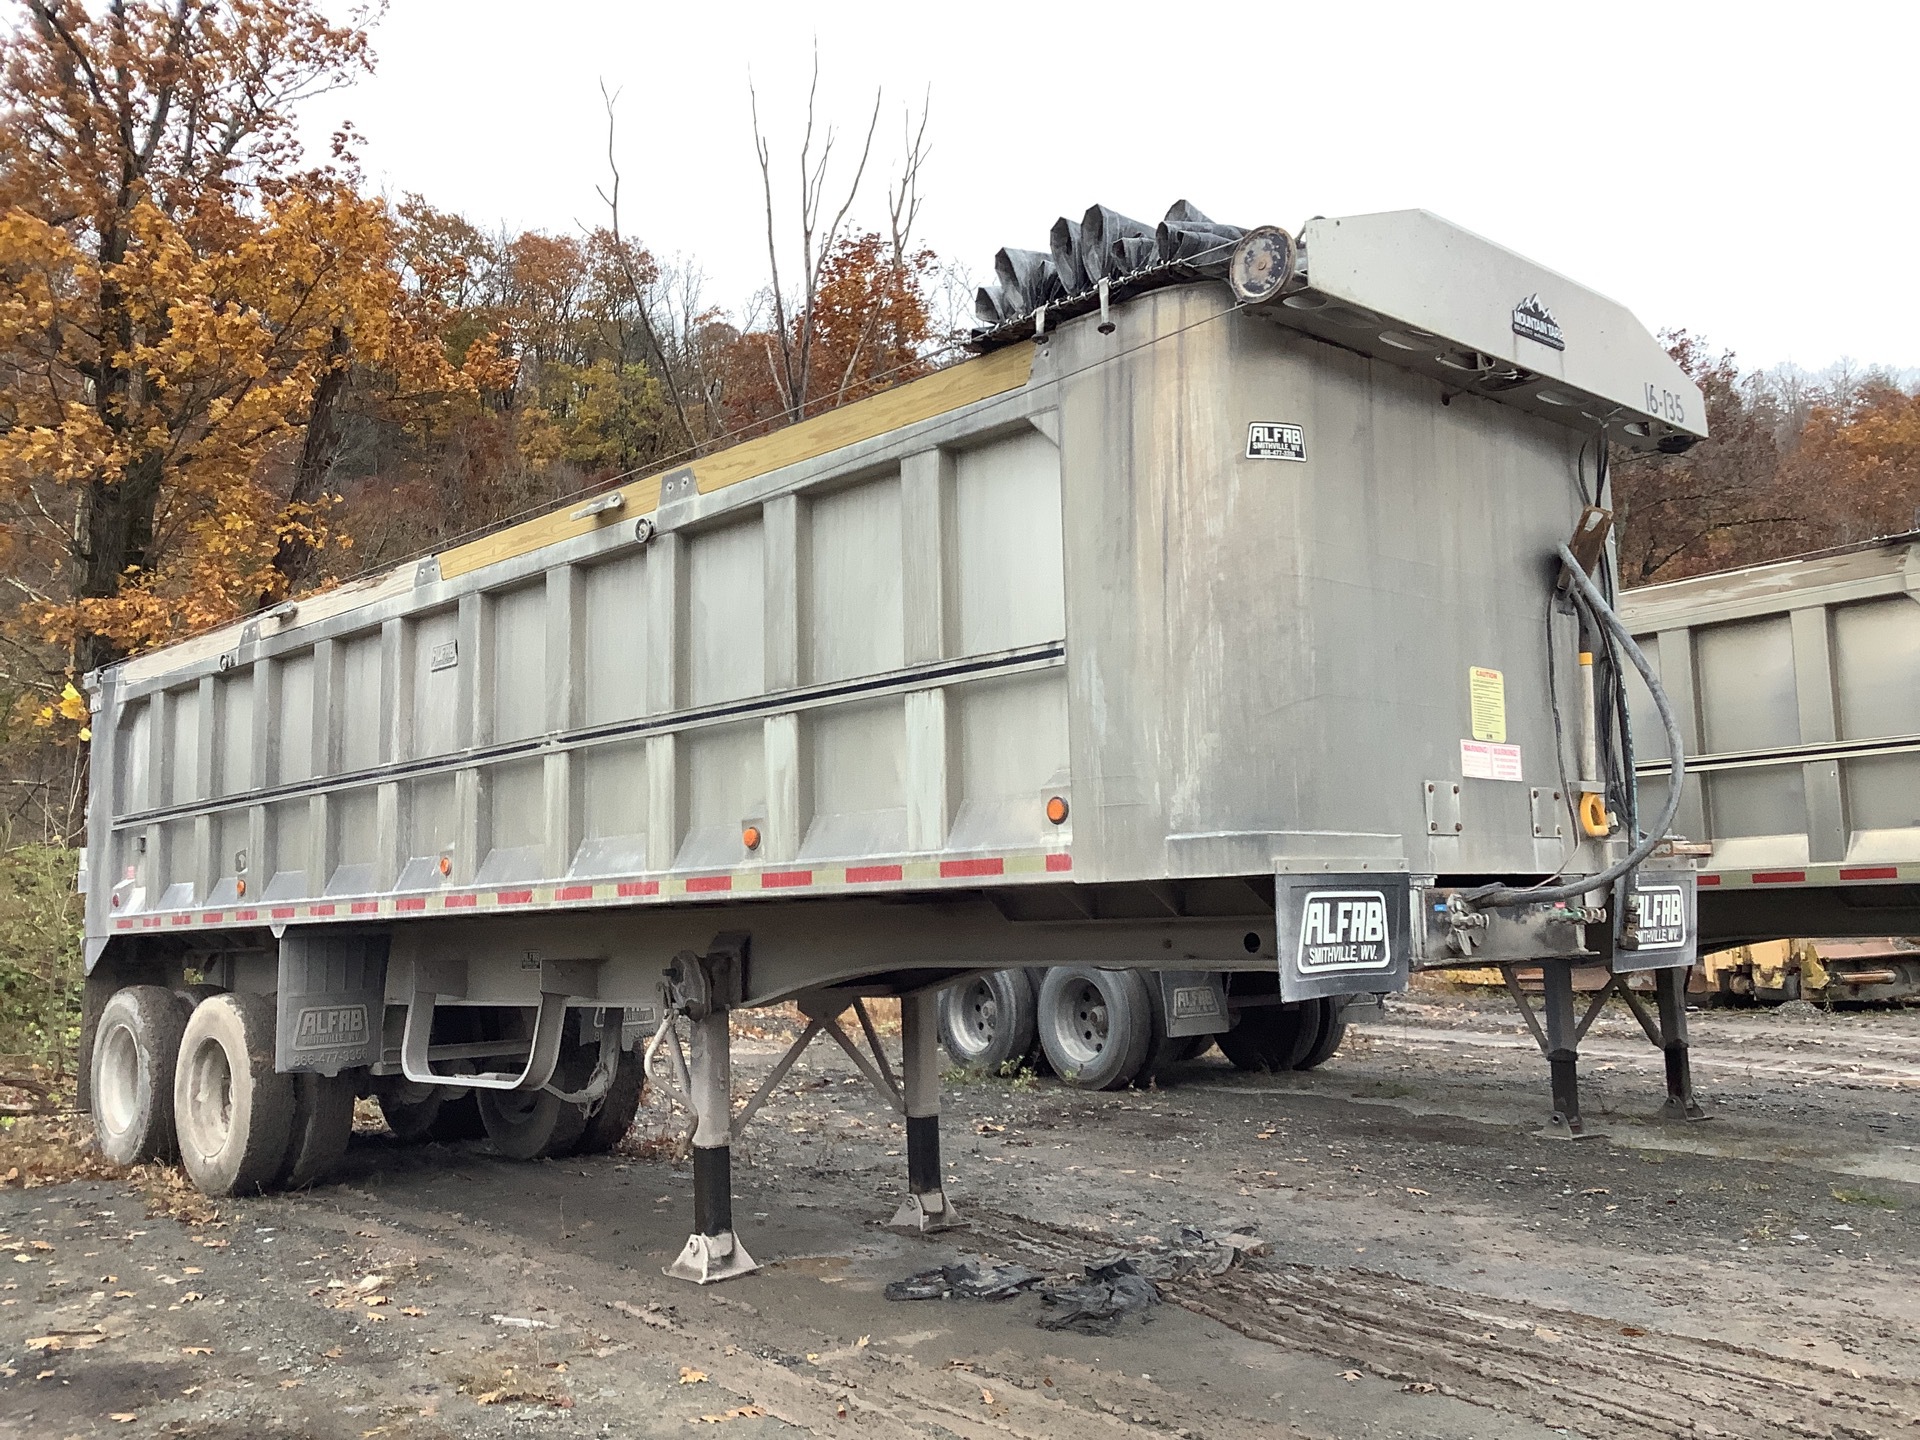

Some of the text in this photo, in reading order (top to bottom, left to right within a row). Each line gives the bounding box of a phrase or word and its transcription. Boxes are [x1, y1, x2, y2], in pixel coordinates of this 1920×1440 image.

[1514, 310, 1548, 335] MOUNTAIN
[1644, 382, 1685, 423] 16-135
[1252, 427, 1301, 445] ALFAB
[1476, 670, 1498, 679] CAUTION
[1304, 902, 1384, 945] ALFAB
[1309, 944, 1378, 964] SMITHVILLE, WV.
[301, 1009, 364, 1036] ALFAB
